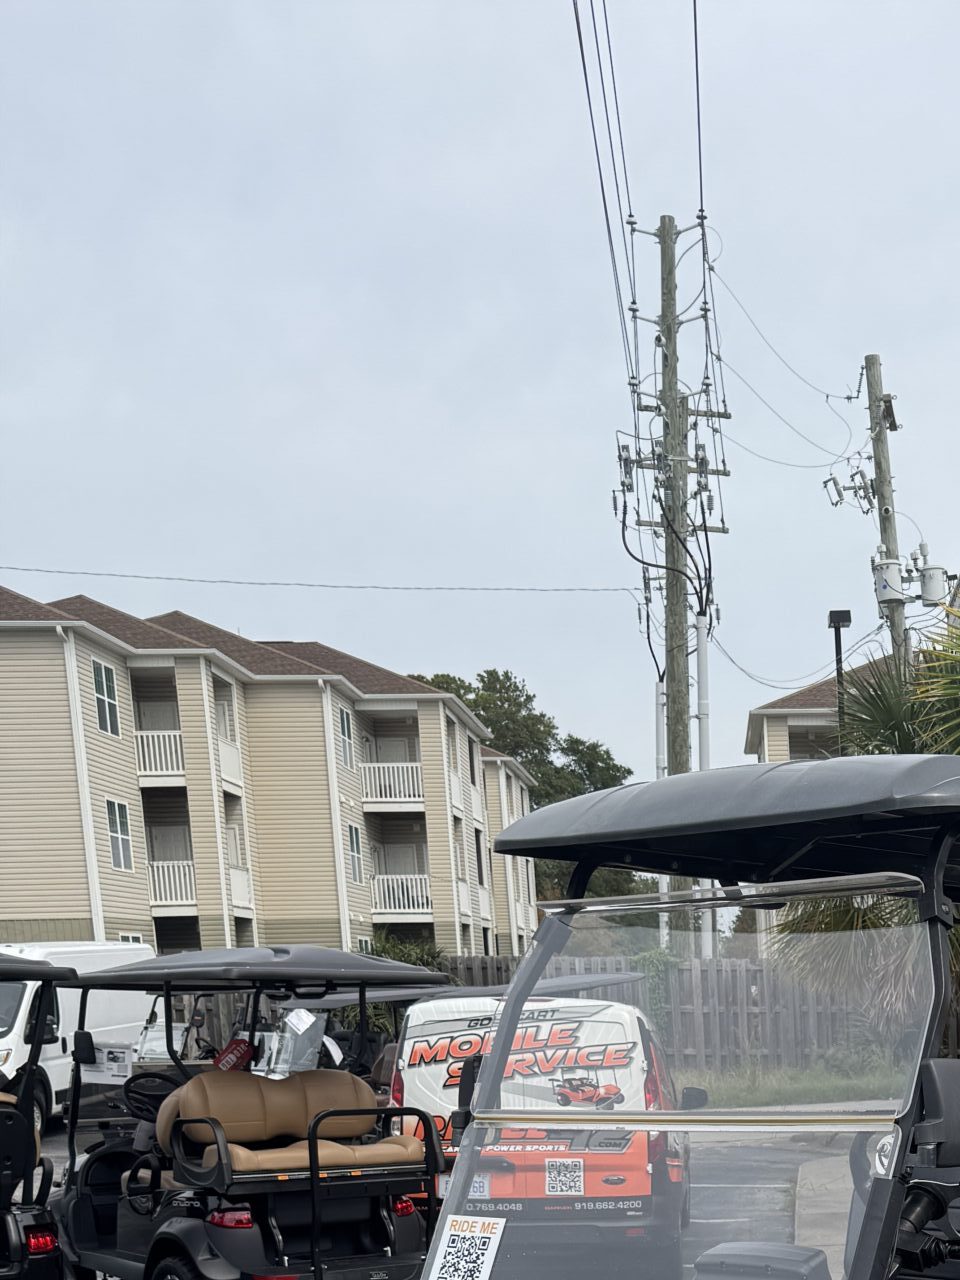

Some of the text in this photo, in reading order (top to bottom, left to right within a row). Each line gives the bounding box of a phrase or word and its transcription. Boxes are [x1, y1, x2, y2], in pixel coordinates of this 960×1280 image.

[442, 1041, 637, 1087] SRVICE
[486, 1144, 524, 1152] POWER
[449, 1219, 499, 1235] RIDE ME
